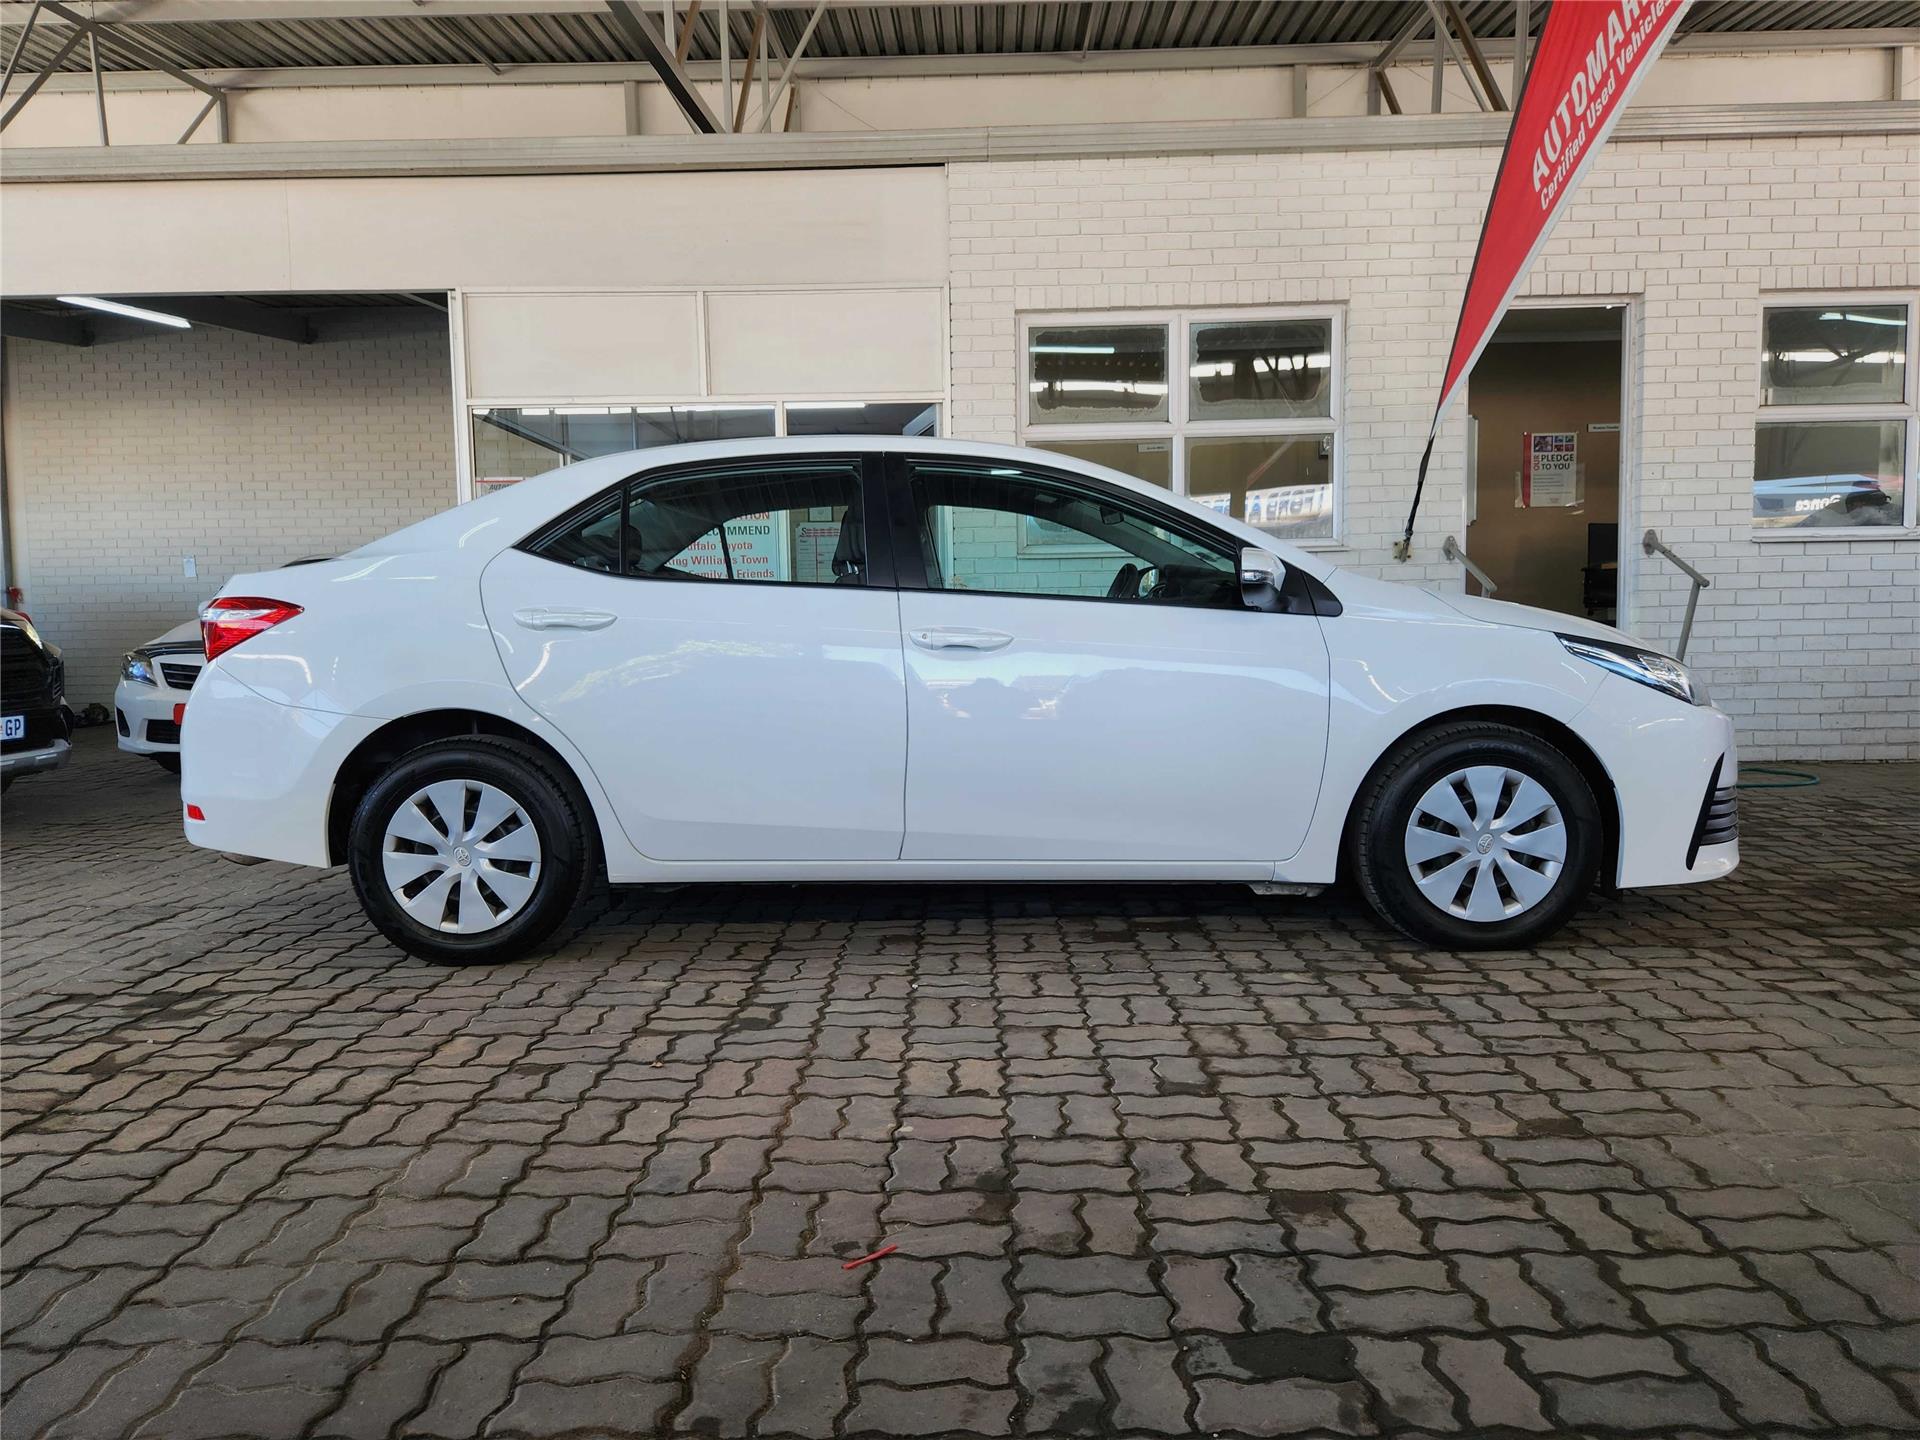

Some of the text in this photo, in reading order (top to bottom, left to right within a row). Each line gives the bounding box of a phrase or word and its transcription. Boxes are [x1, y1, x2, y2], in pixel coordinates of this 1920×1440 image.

[1533, 0, 1651, 192] AUTOMAR
[1541, 122, 1587, 210] Certified
[1586, 69, 1616, 129] Used
[1541, 453, 1575, 462] PLEDGE
[687, 541, 753, 552] uffalo oyota
[690, 555, 738, 565] Willias
[741, 555, 769, 564] Town
[737, 569, 774, 579] Friends
[5, 719, 21, 737] GP
